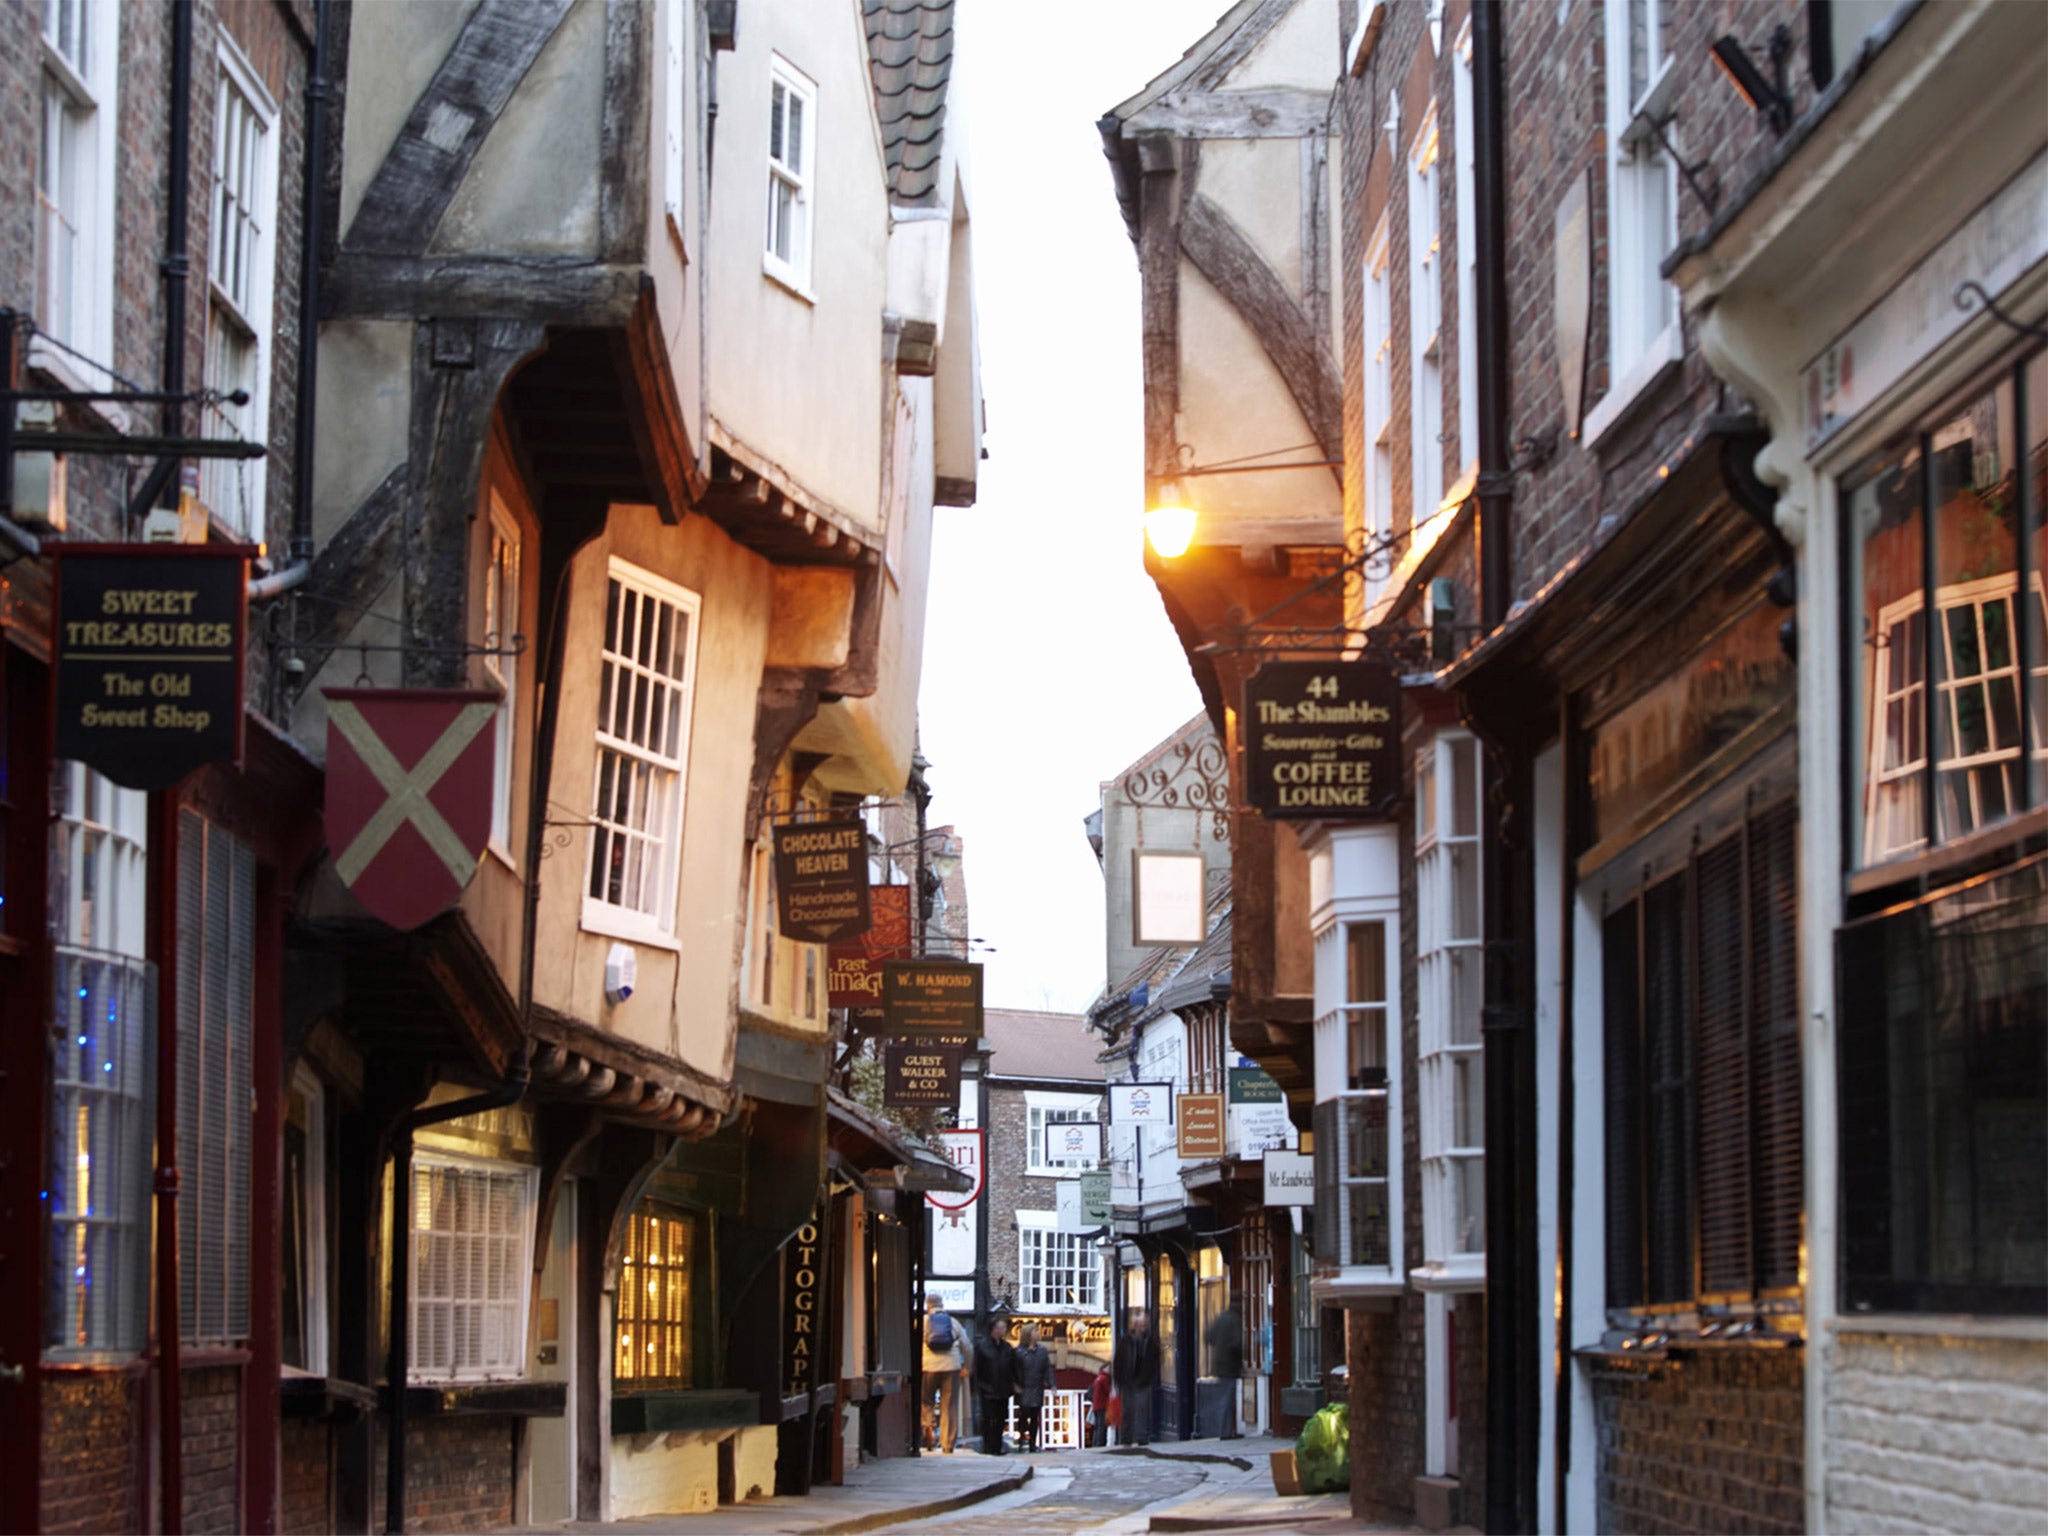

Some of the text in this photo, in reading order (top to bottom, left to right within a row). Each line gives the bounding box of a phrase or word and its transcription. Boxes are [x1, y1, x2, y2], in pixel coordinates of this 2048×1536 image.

[102, 589, 198, 615] SWEET
[66, 621, 233, 647] TREASURES
[103, 672, 191, 697] The Old
[1305, 675, 1339, 699] 44
[81, 703, 211, 732] Sweet Shop
[1257, 701, 1390, 723] The Shambles
[1273, 761, 1372, 784] COFFEE
[1279, 786, 1370, 807] LOUNGE
[782, 830, 860, 854] CHOCOLATE
[796, 853, 849, 875] HEAVEN
[789, 889, 858, 906] Handmade
[789, 907, 860, 922] Chocolates
[838, 958, 869, 972] Past
[916, 973, 973, 987] HAMOND
[904, 1055, 944, 1066] GUEST
[900, 1067, 948, 1078] WALKER
[908, 1079, 939, 1090] & CO
[789, 1208, 817, 1396] OTOGRAPH
